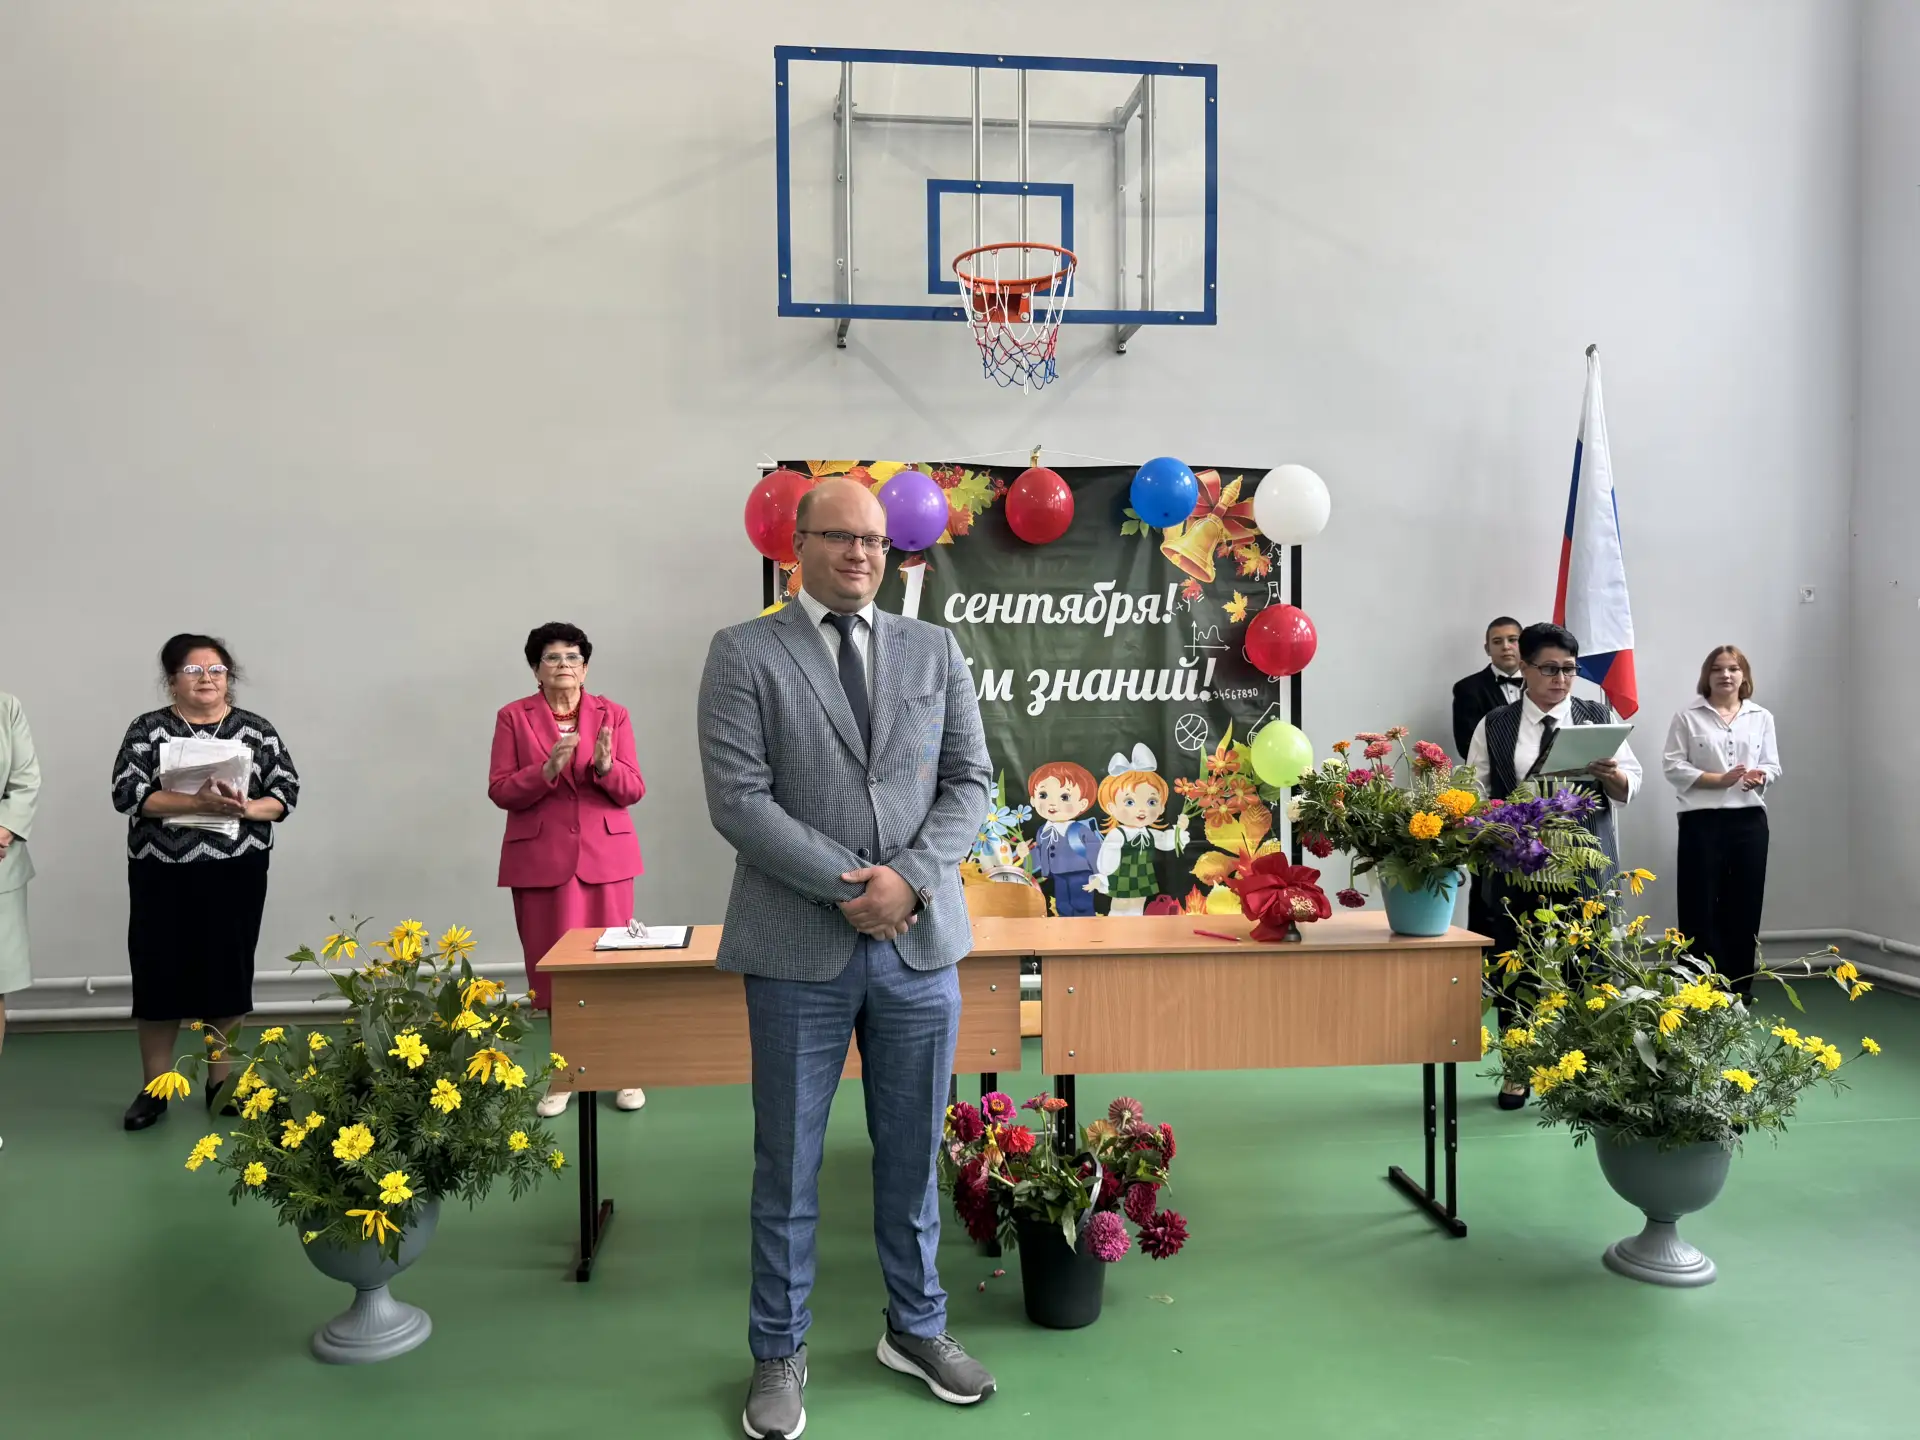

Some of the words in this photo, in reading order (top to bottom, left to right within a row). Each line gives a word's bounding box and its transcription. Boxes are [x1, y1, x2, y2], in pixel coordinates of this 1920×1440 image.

[899, 562, 926, 619] 1
[944, 580, 1178, 637] сентября!
[1026, 656, 1217, 716] знаний!
